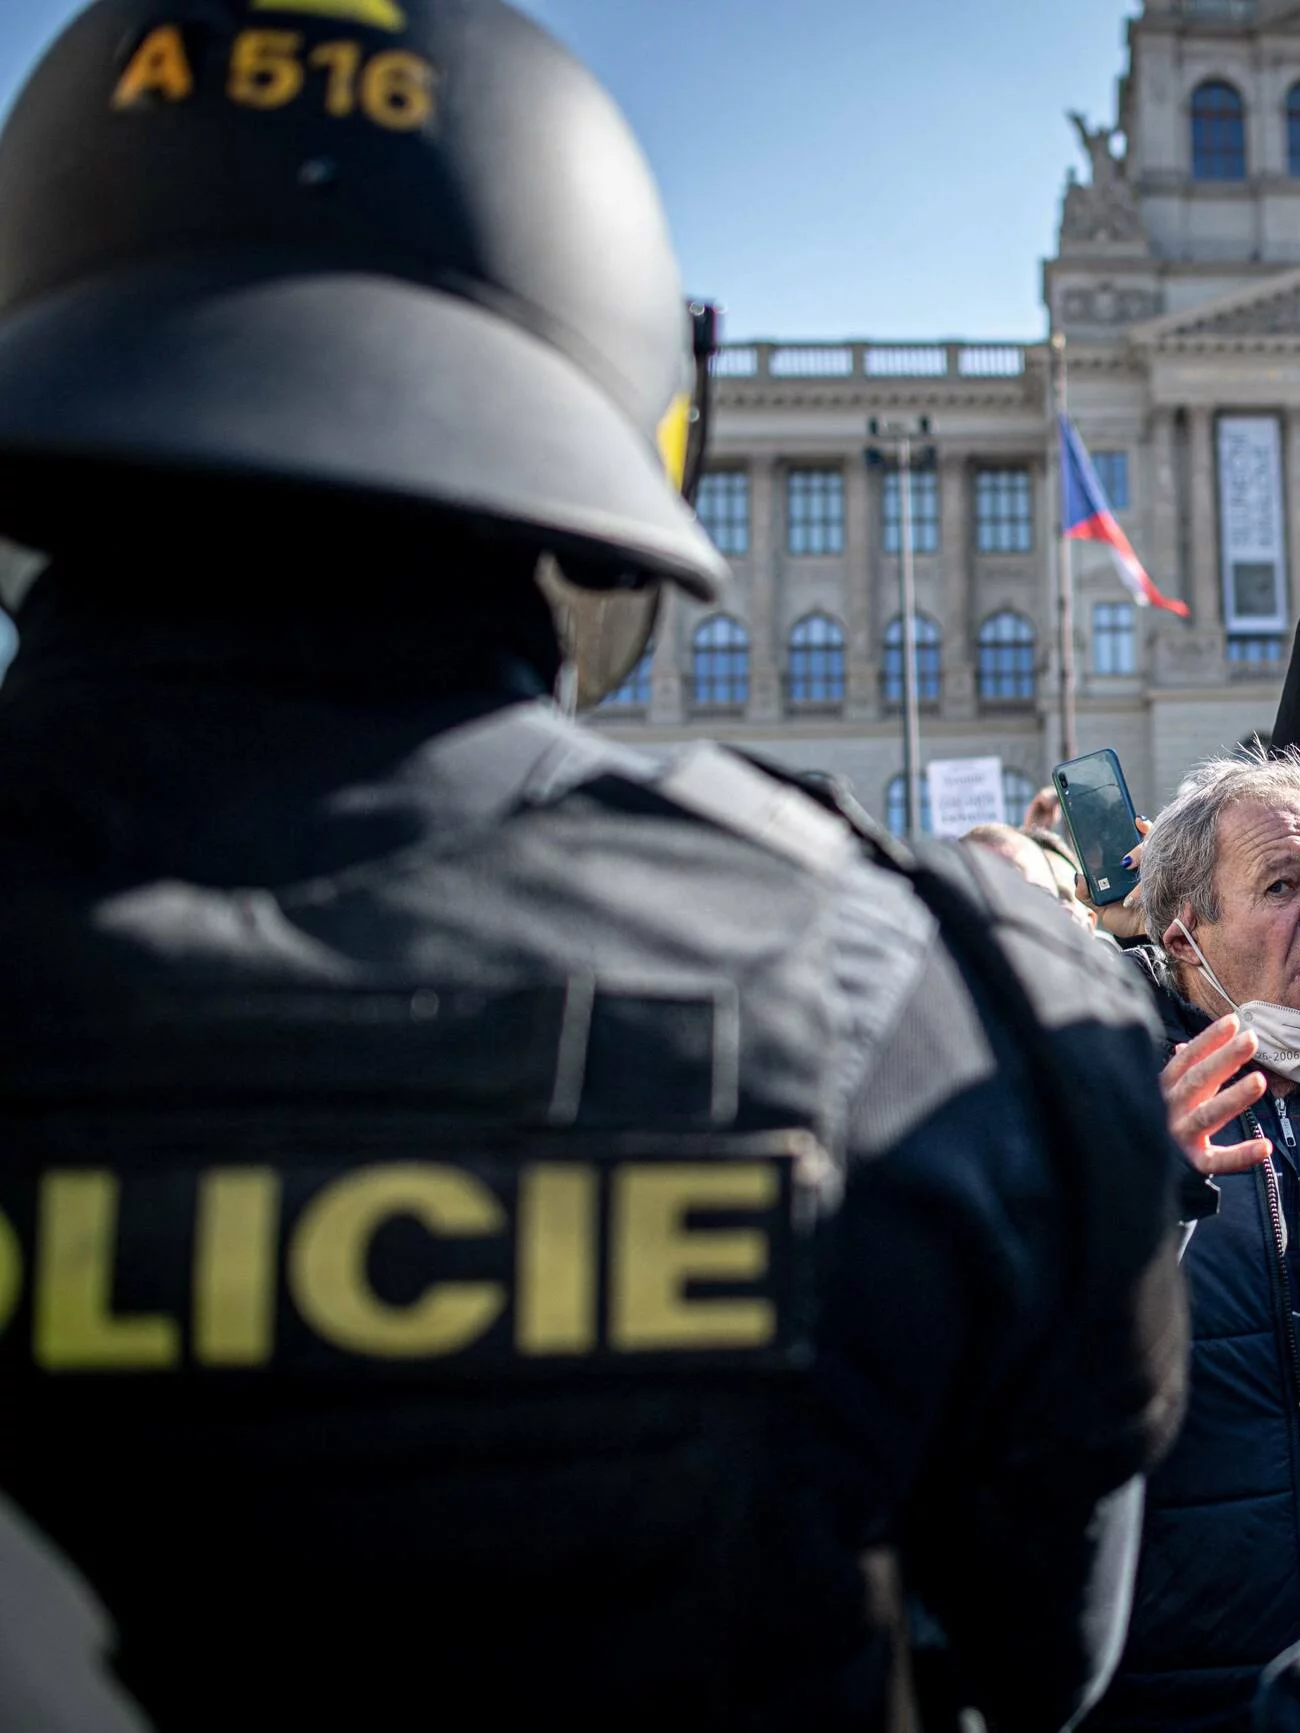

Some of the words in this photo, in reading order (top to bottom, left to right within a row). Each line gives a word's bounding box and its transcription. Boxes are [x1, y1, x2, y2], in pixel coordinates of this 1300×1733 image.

[112, 25, 192, 108] A
[230, 30, 434, 131] 516
[0, 1161, 780, 1371] LICIE
